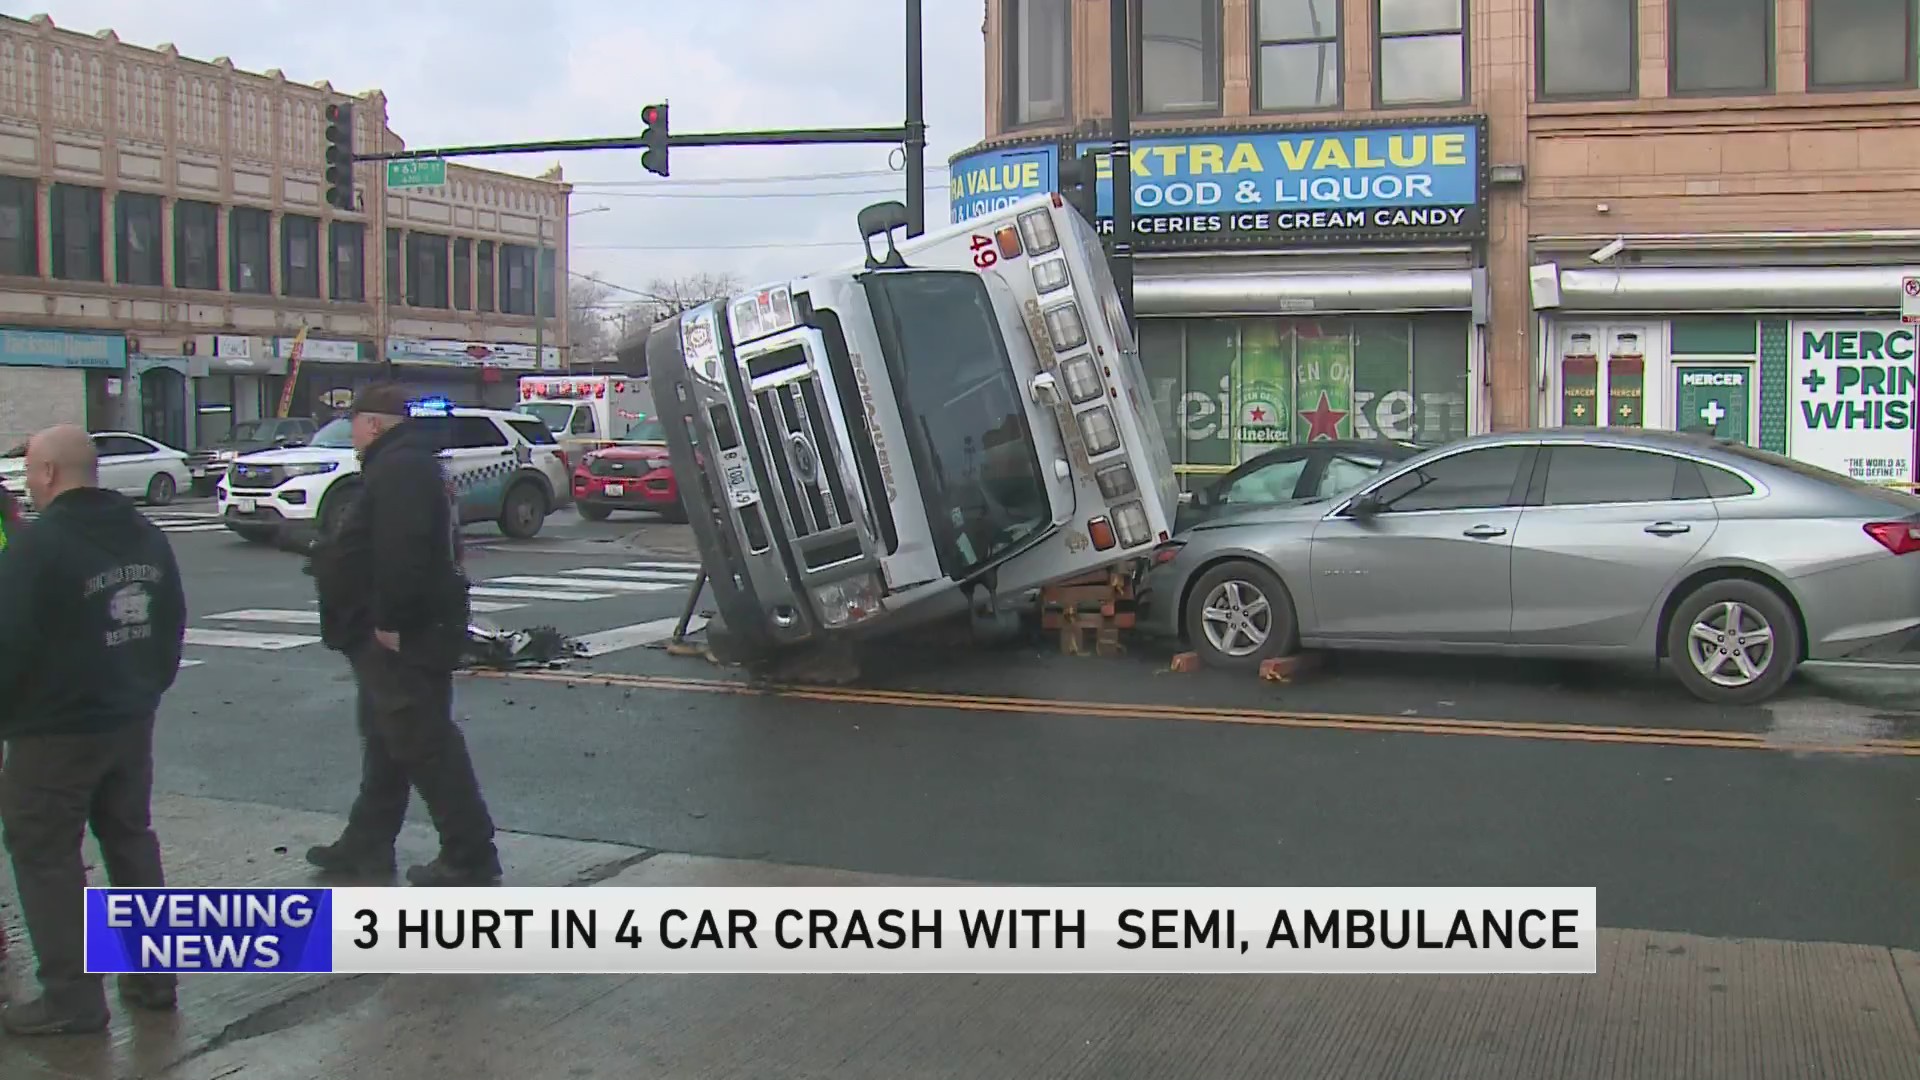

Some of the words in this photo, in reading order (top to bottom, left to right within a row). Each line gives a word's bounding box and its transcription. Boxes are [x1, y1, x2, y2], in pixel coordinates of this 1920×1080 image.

[1277, 134, 1466, 171] VALUE
[966, 162, 1040, 195] VALUE
[1133, 180, 1222, 207] OOD
[1234, 180, 1263, 204] &
[1275, 174, 1433, 203] LIQUOR
[1096, 215, 1221, 235] RCERIES
[1230, 213, 1269, 230] ICE
[1277, 210, 1365, 229] CREAM
[1373, 207, 1465, 227] CANDY
[970, 234, 997, 268] 49
[1683, 373, 1743, 386] MERCER
[1849, 468, 1864, 478] YOU
[1866, 468, 1894, 478] DEFINE
[1865, 458, 1894, 468] WORLD
[1895, 458, 1906, 468] AS
